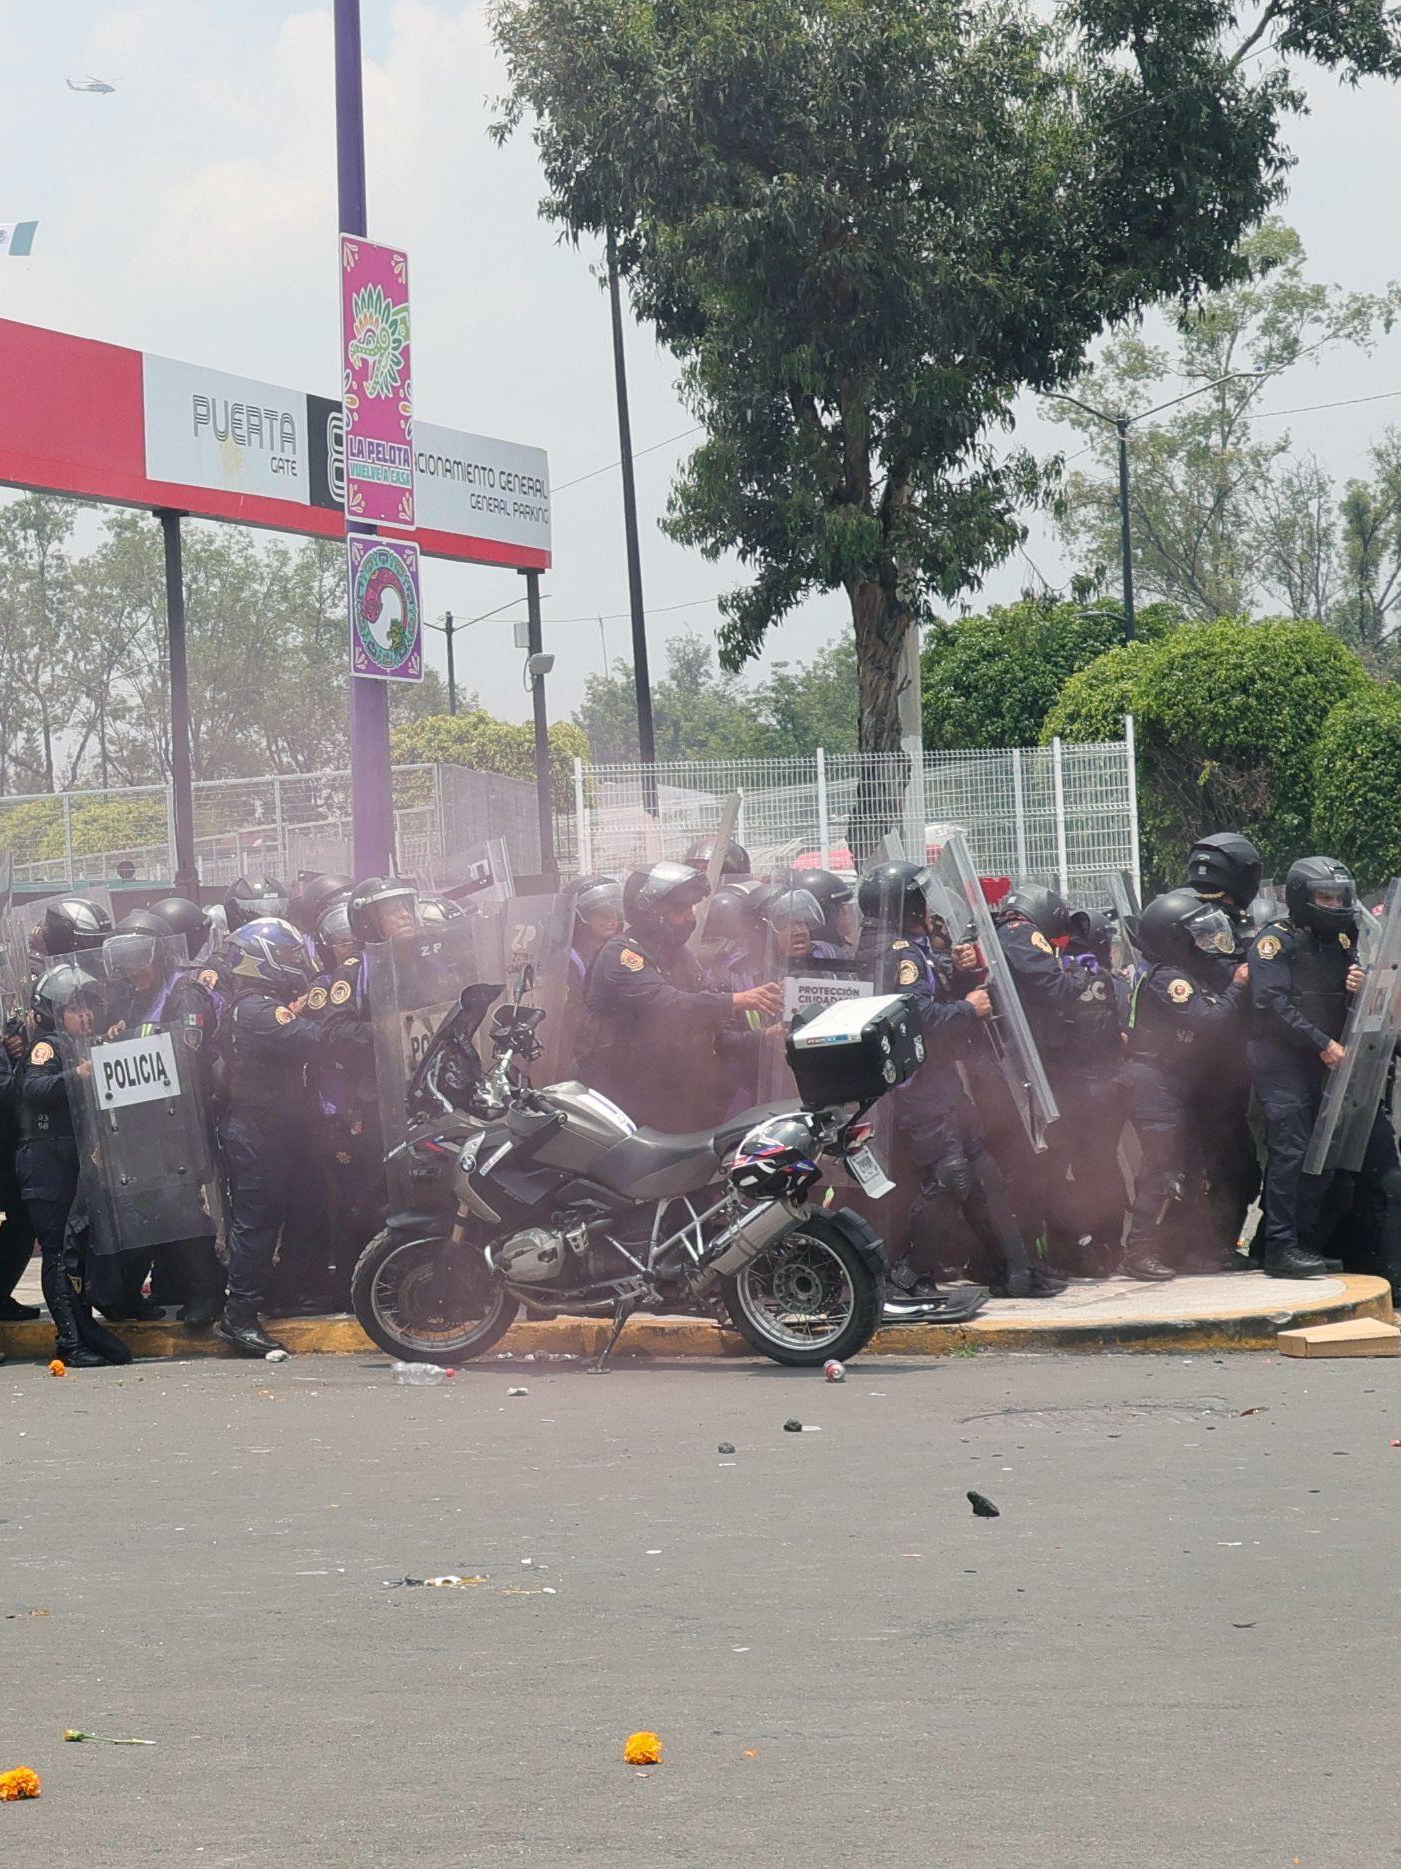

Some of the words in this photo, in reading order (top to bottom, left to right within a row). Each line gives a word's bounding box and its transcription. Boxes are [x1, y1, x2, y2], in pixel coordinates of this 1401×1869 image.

[192, 394, 297, 456] PUERTA
[348, 436, 365, 460] LA
[366, 439, 411, 469] PELOTA
[271, 458, 298, 477] GATE
[349, 462, 382, 482] VUELVE
[383, 467, 390, 483] A
[390, 469, 412, 488] CASA
[499, 470, 549, 500] GENERAL
[470, 493, 511, 517] GENERAL
[798, 985, 860, 997] PROTECCIÓN
[103, 1051, 168, 1091] POLICIA
